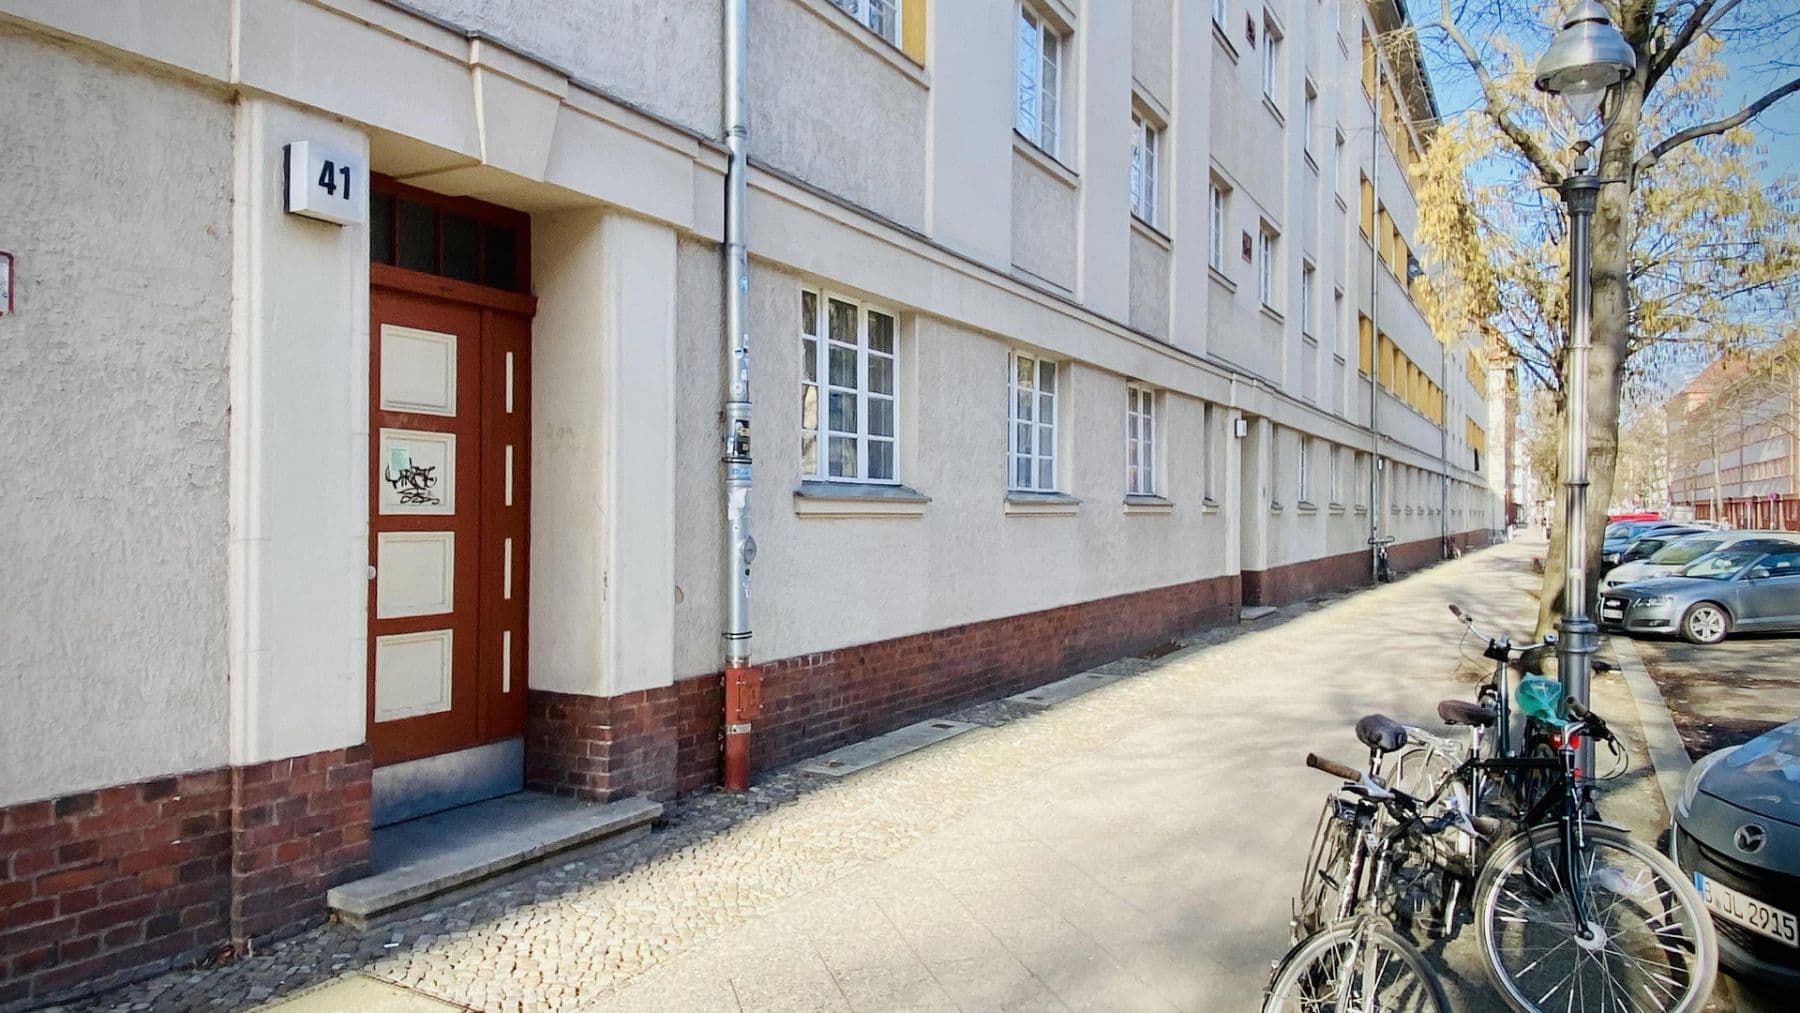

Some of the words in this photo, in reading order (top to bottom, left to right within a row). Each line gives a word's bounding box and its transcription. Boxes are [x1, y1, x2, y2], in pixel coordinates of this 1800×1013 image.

[318, 160, 351, 200] 41
[1723, 891, 1744, 919] JL
[1748, 902, 1796, 941] 2915
